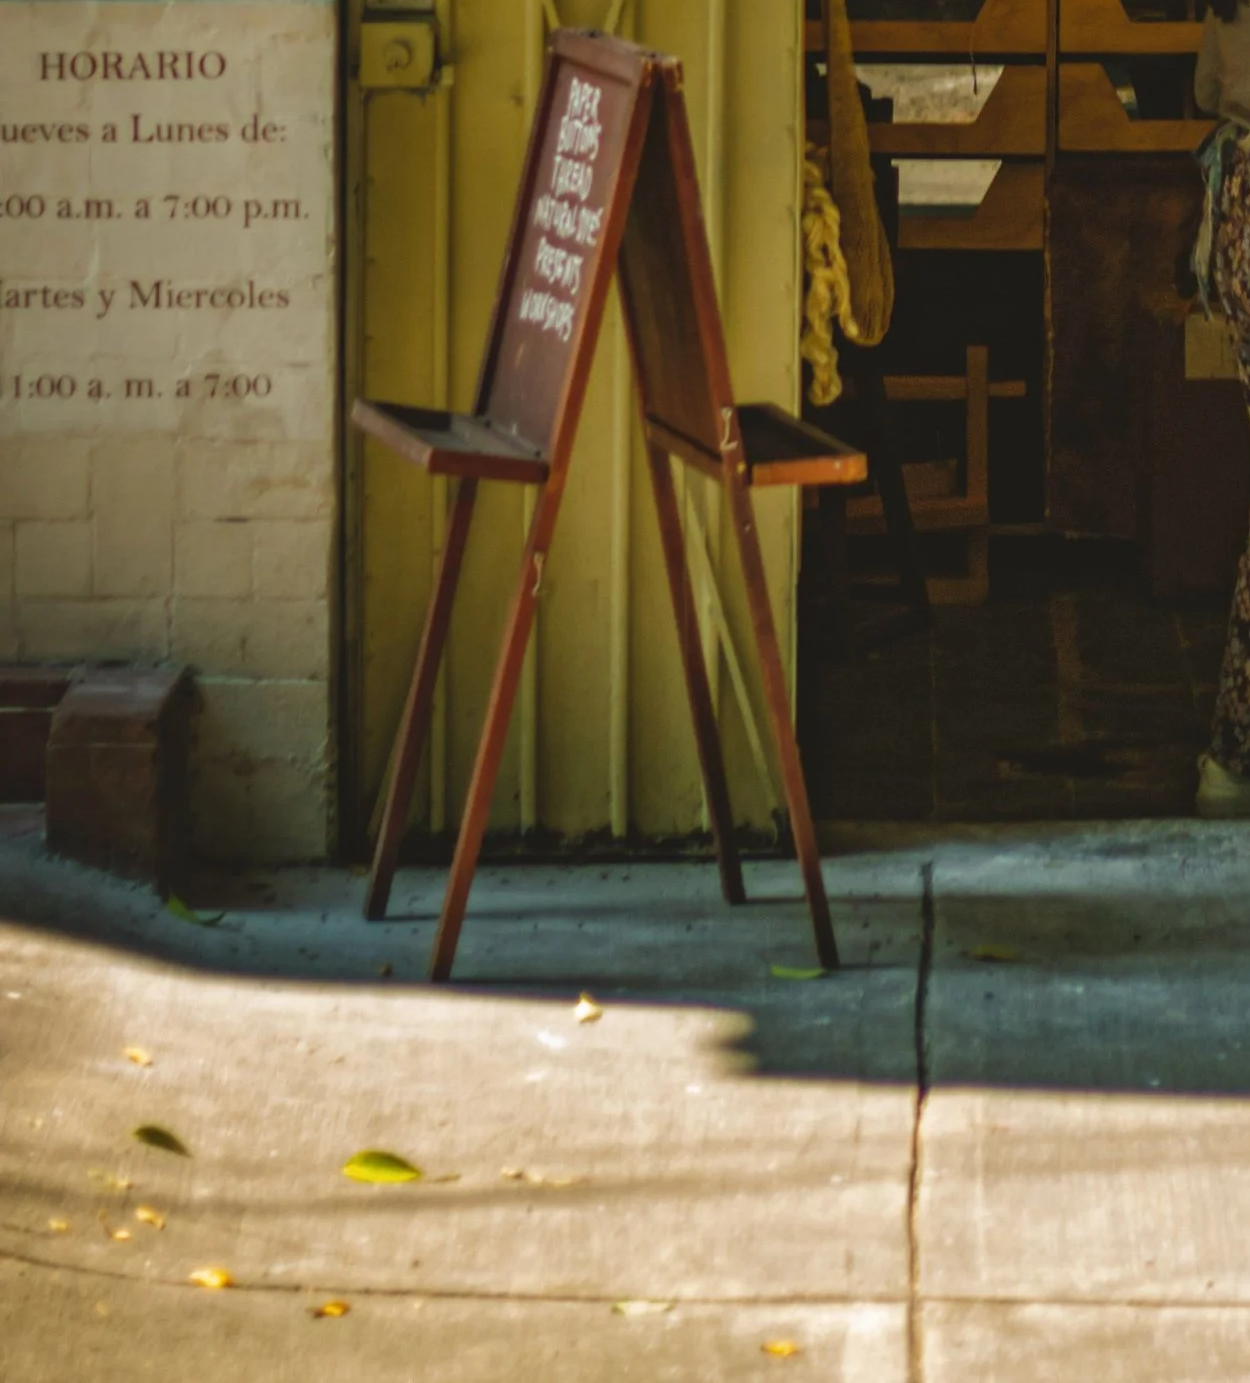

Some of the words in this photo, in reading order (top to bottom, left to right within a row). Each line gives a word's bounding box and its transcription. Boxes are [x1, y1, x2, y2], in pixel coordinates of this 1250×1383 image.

[39, 51, 227, 81] HORARIO
[0, 122, 90, 144] ueves
[101, 122, 118, 144] a
[131, 114, 229, 144] Lunes
[241, 115, 287, 144] de:
[0, 194, 46, 220] :00
[57, 198, 122, 220] a.m.
[134, 198, 151, 220] a
[164, 195, 232, 220] 7:00
[243, 198, 310, 228] p.m.
[0, 280, 85, 310] artes
[96, 289, 116, 320] y
[129, 280, 290, 310] Miercoles
[0, 374, 77, 400] 1:00
[87, 378, 112, 400] a.
[125, 378, 163, 400] m.
[175, 378, 191, 400] a
[204, 374, 272, 400] 7:00
